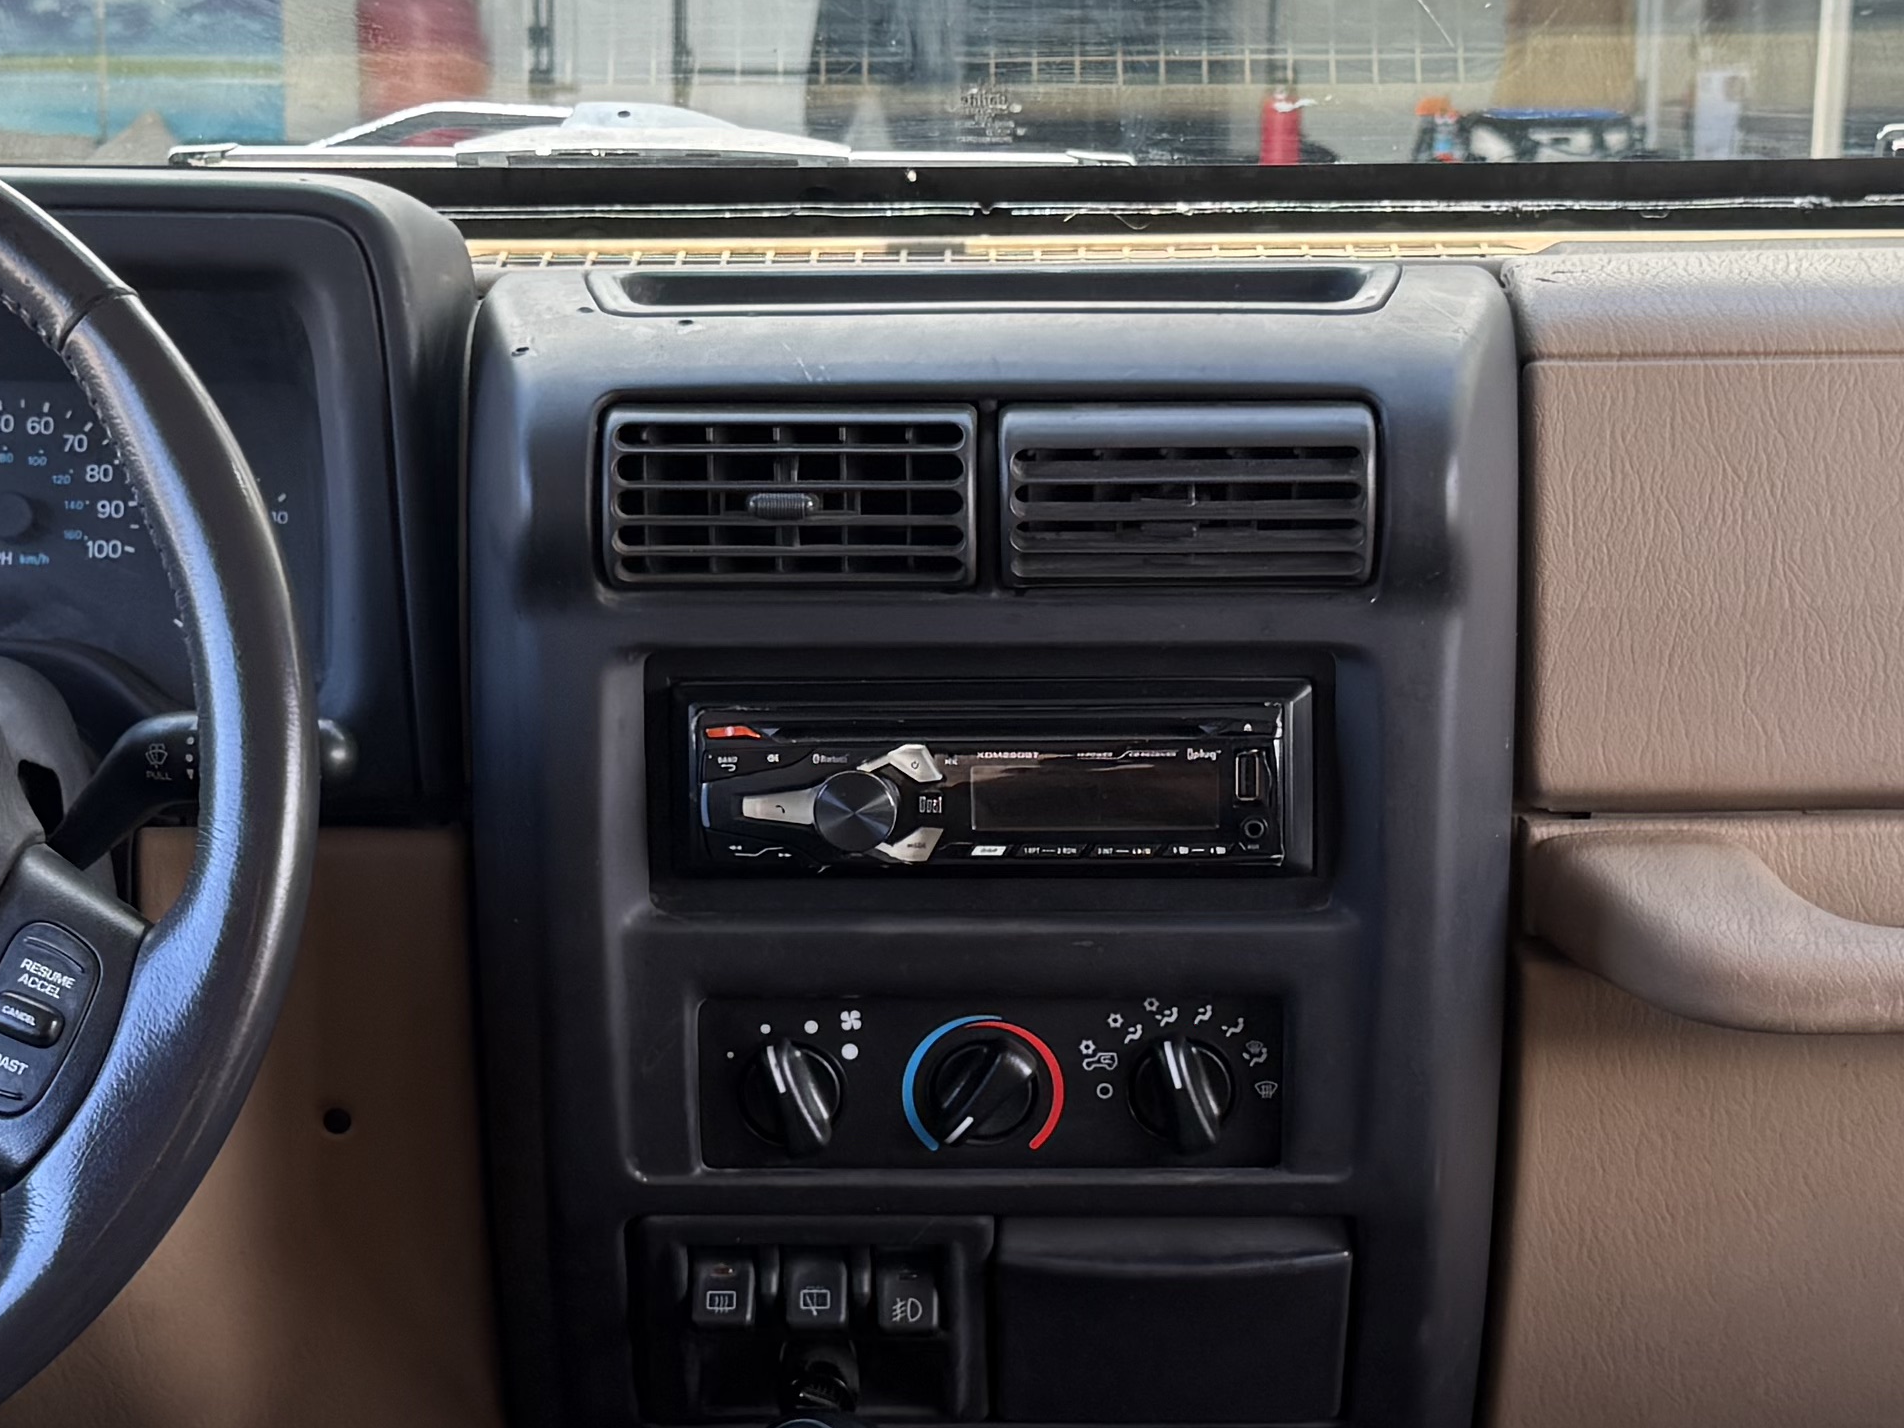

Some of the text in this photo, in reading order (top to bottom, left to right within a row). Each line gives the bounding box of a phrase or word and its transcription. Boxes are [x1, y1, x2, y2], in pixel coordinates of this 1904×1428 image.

[26, 417, 54, 434] 60
[63, 434, 88, 452] 70
[28, 456, 47, 466] 100
[52, 475, 71, 484] 120
[86, 465, 113, 482] 80
[65, 501, 84, 510] 140
[97, 501, 124, 518] 90
[86, 540, 122, 558] 100
[19, 553, 49, 566] km/h
[20, 958, 76, 989] RESUME
[17, 973, 61, 999] ACCEL
[1, 1005, 36, 1026] CANCEL
